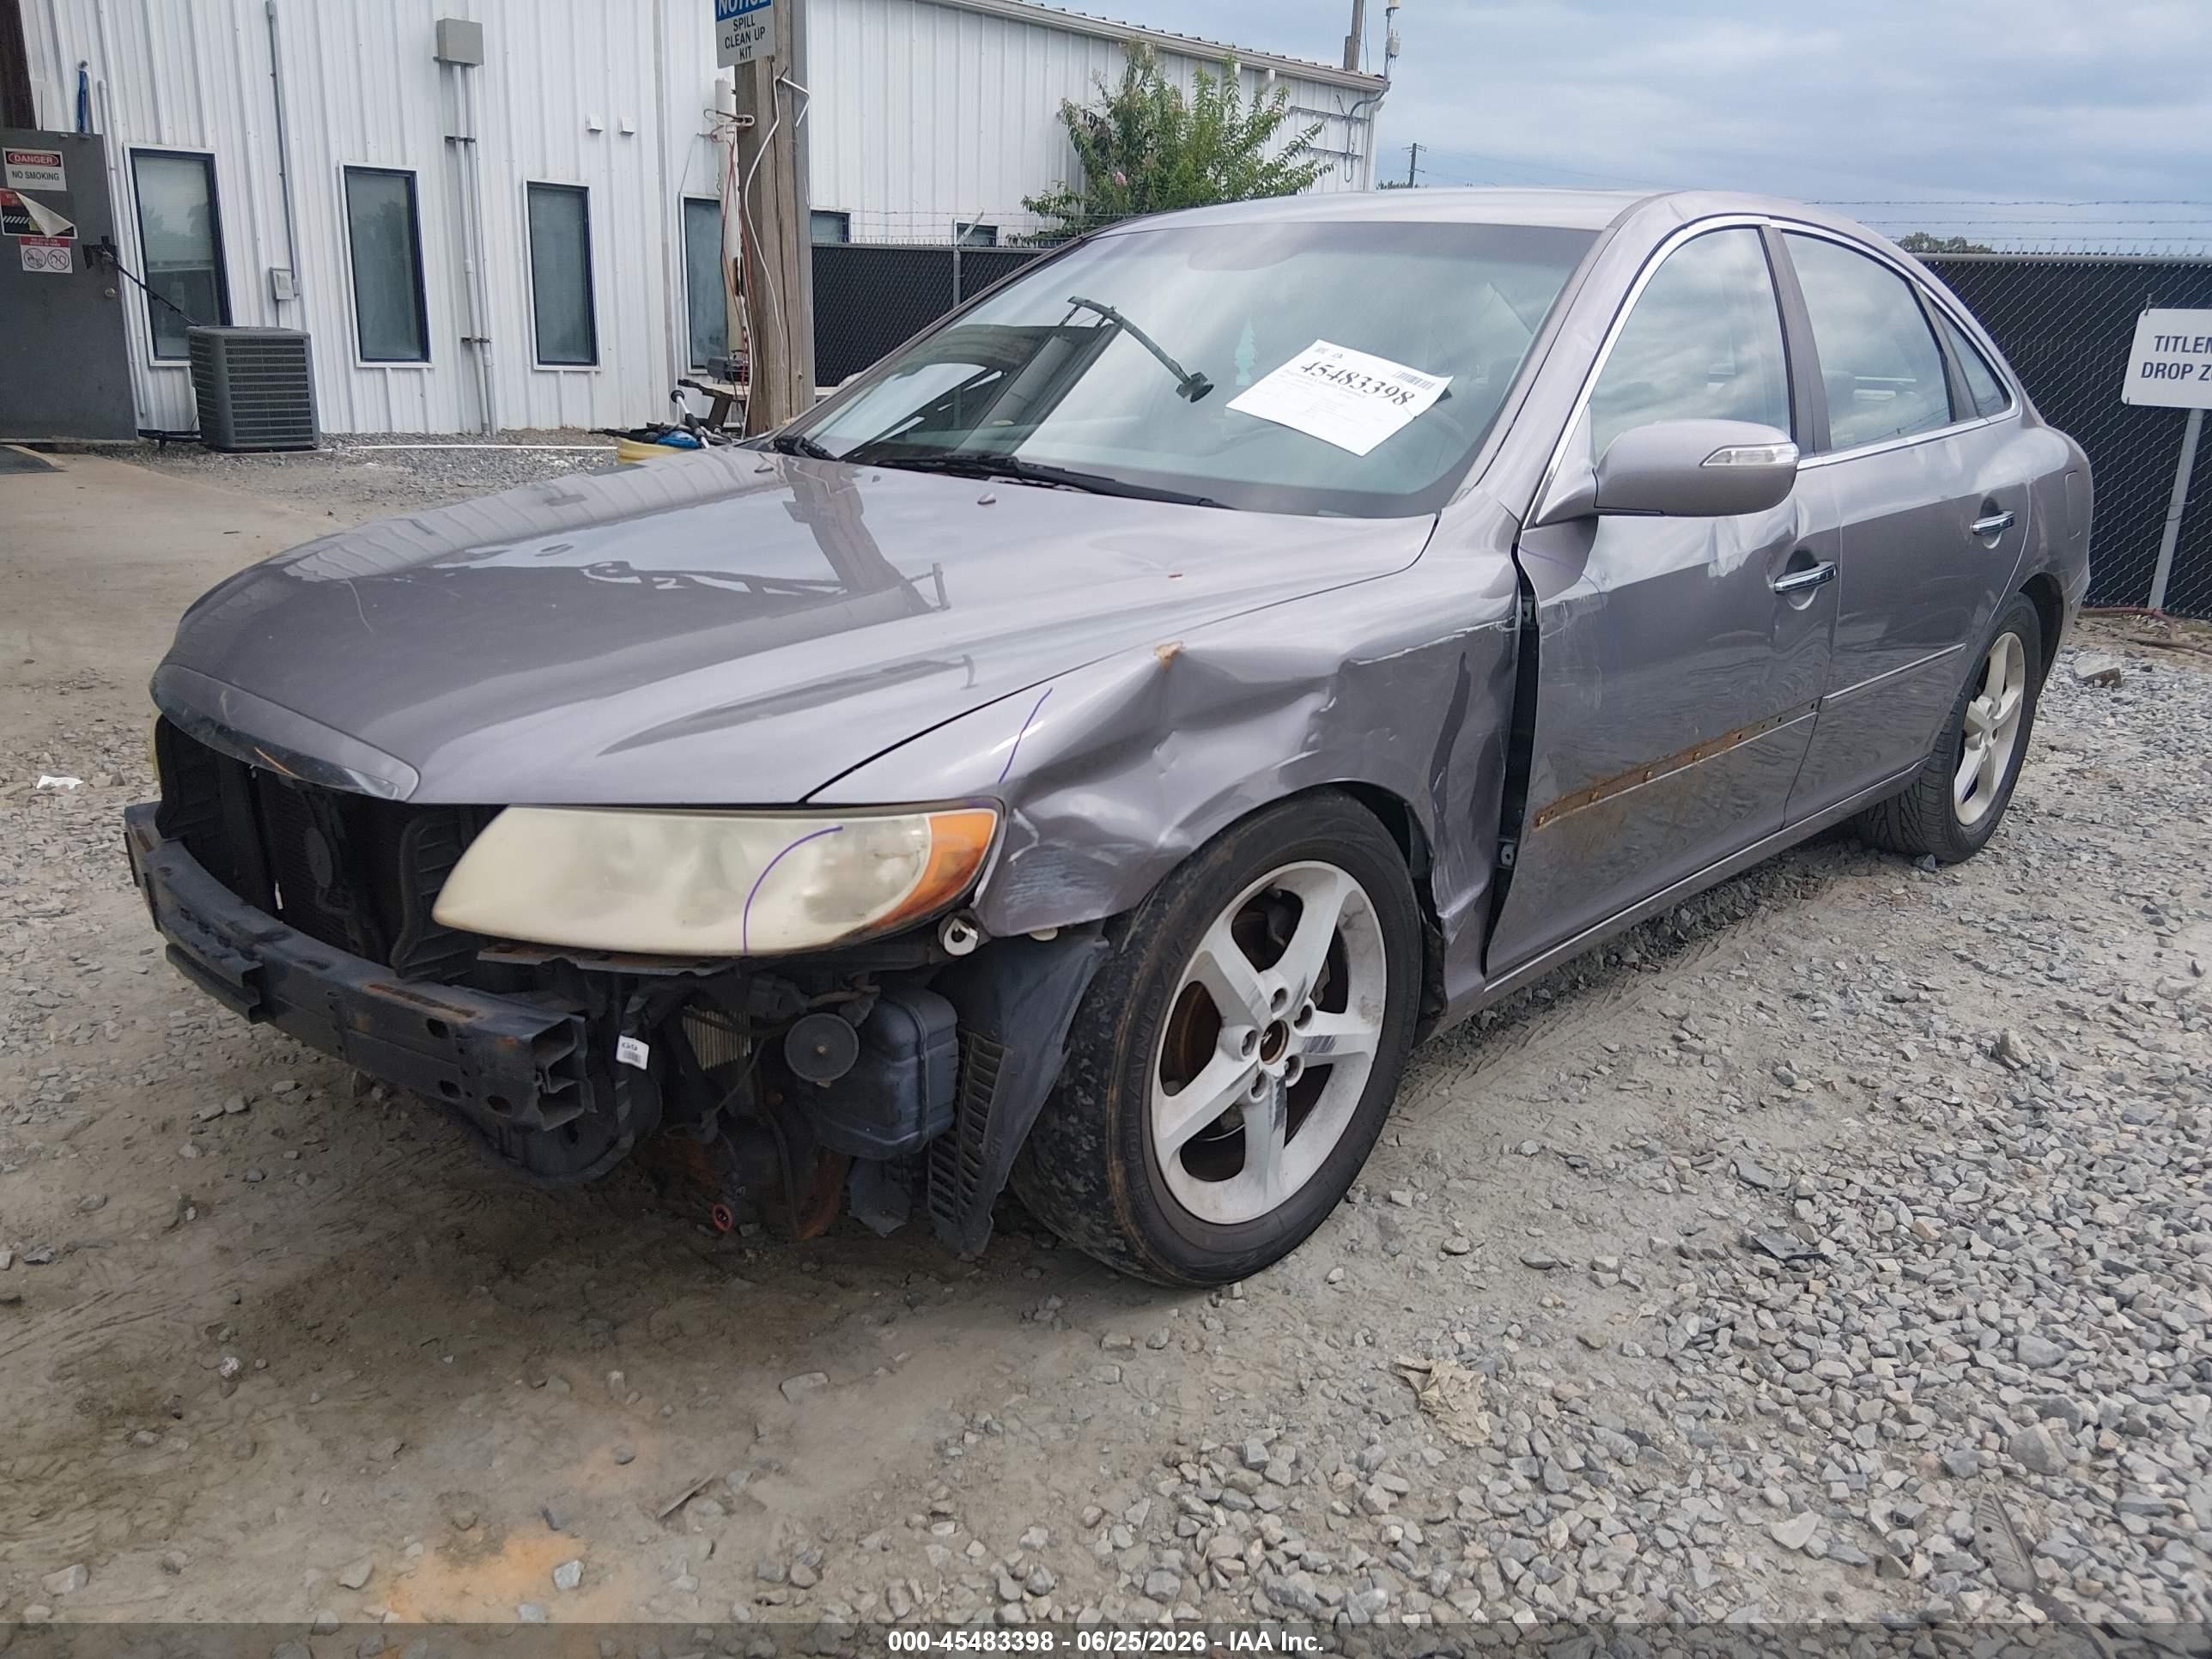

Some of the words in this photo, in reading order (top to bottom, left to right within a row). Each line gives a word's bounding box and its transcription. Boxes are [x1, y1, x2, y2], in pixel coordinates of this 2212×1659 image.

[732, 14, 756, 32] SPILL
[725, 30, 751, 49] CLEAN
[754, 26, 766, 41] UP
[739, 46, 752, 61] KIT
[14, 154, 53, 165] DANGER
[12, 171, 23, 179] NO
[25, 172, 60, 181] SMOKING
[2141, 362, 2194, 380] DROP
[2198, 364, 2212, 381] Z
[1300, 361, 1416, 406] 45483398
